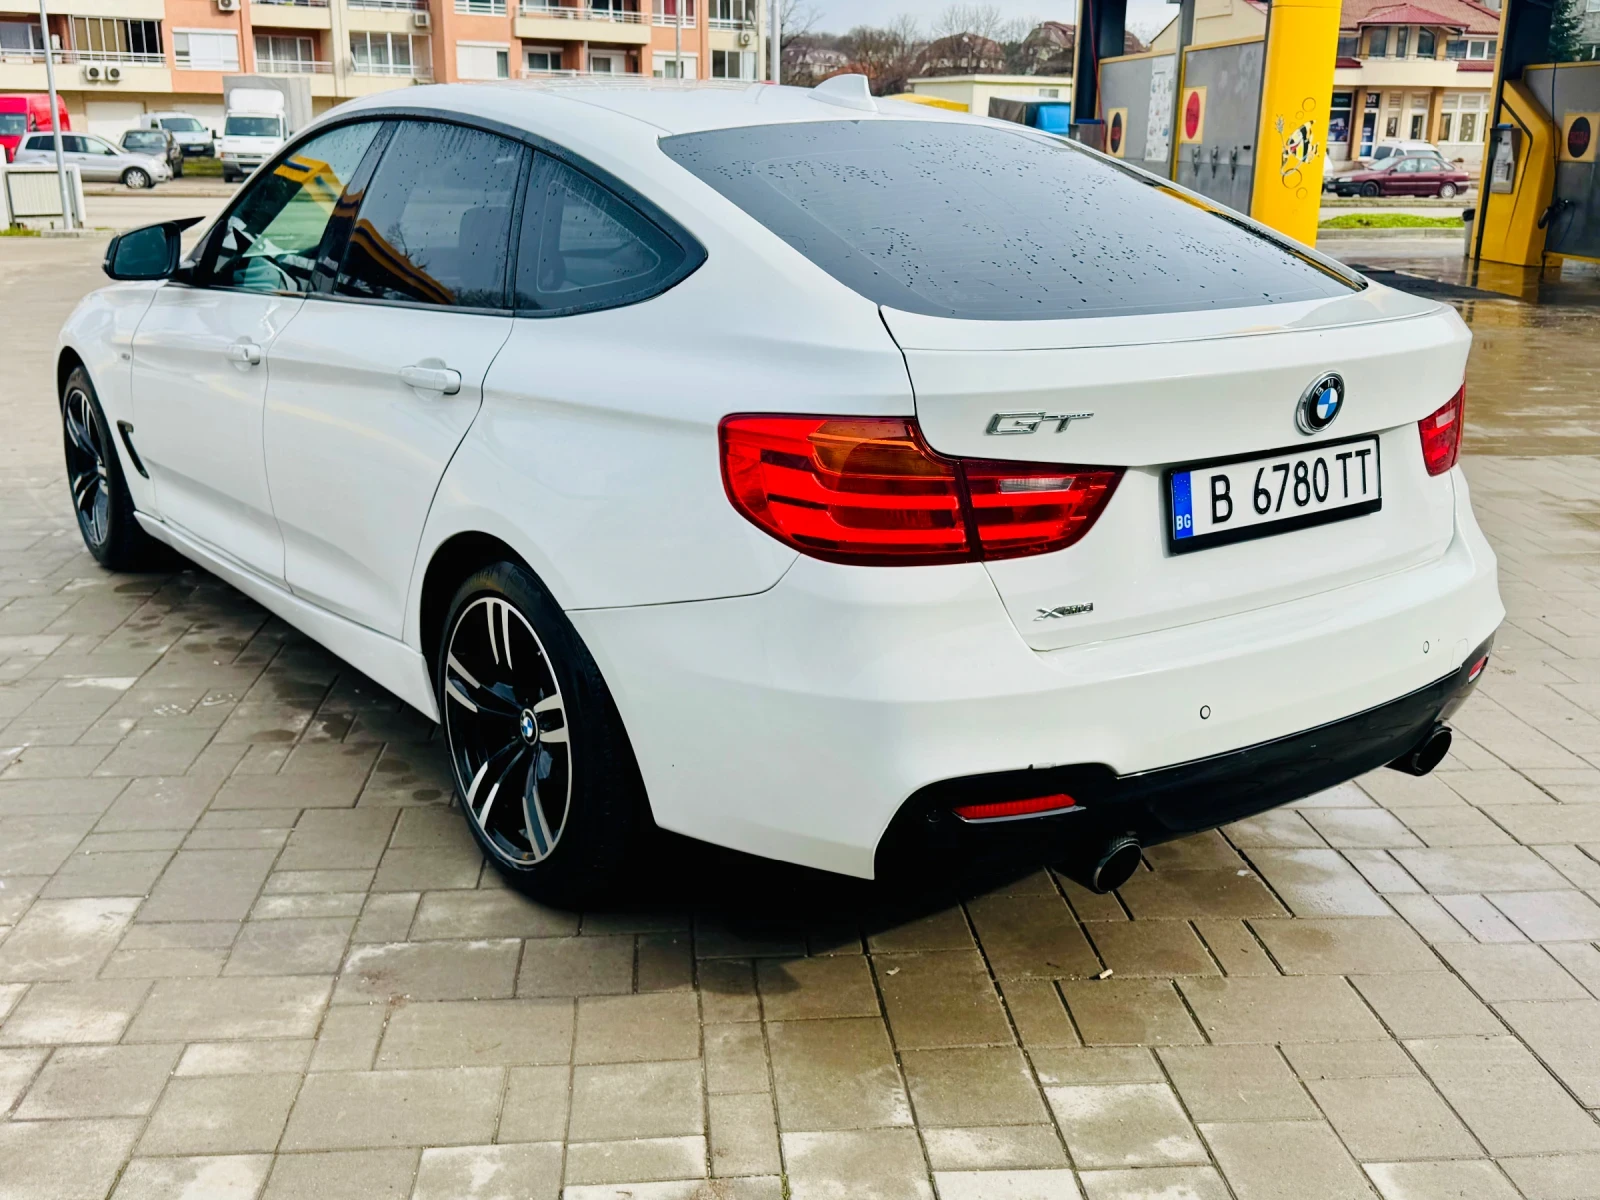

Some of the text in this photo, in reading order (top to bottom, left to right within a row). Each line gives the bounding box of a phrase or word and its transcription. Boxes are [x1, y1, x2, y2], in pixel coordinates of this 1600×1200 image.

[1316, 378, 1342, 397] BMW
[984, 411, 1094, 435] GT
[1210, 448, 1371, 525] B 6780 TT
[1175, 513, 1192, 531] BG
